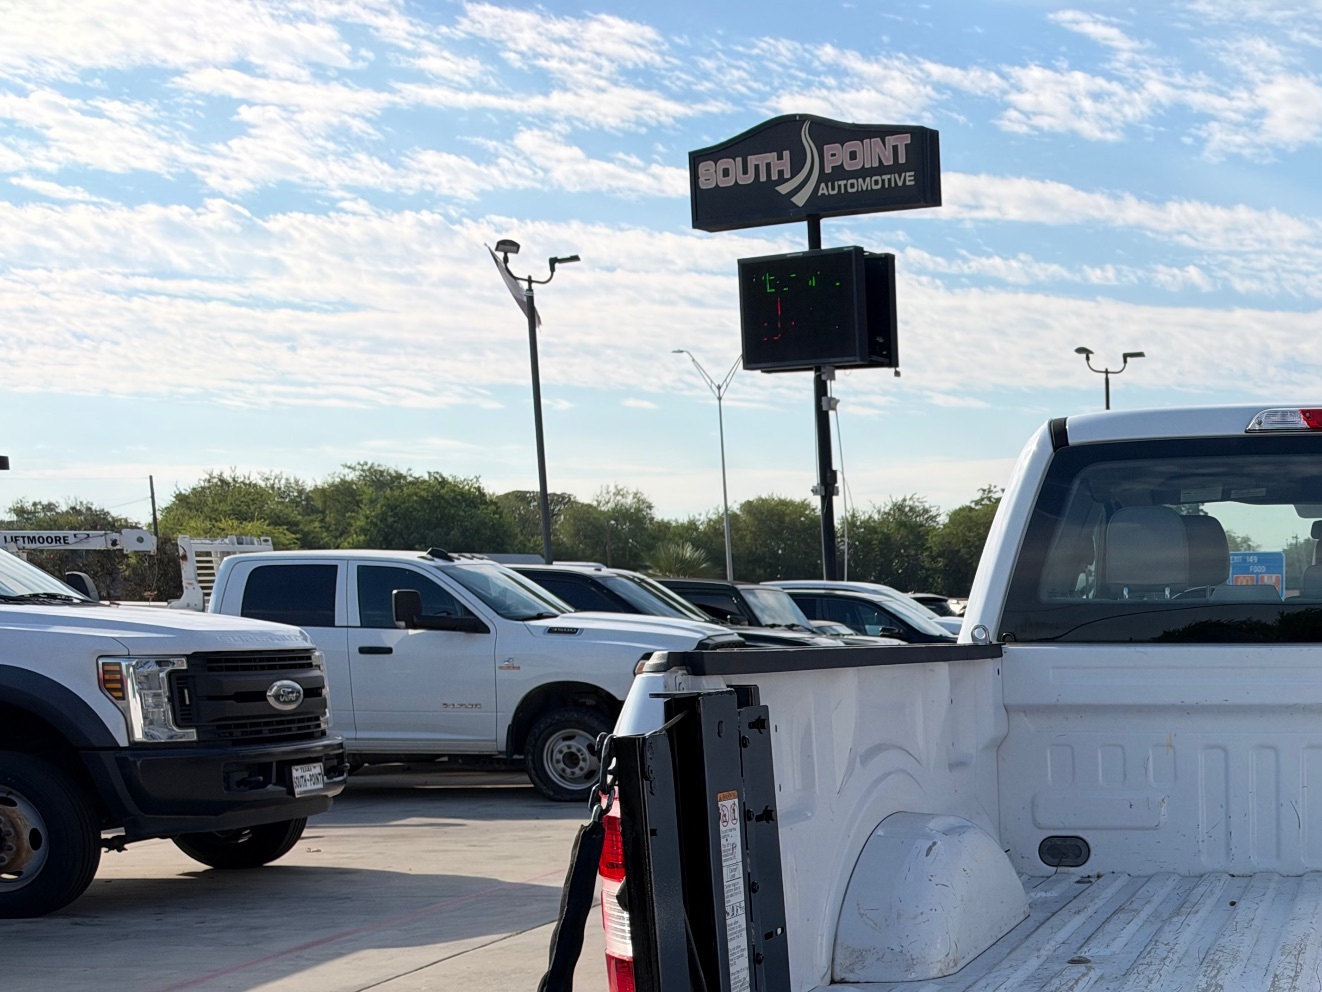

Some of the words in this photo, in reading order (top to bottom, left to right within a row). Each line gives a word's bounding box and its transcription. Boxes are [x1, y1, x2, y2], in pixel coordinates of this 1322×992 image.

[698, 150, 791, 189] SOUTH
[823, 134, 911, 173] POINT
[817, 171, 915, 196] AUTOMOTIVE
[3, 535, 70, 545] LIFTMOORE
[1246, 555, 1258, 563] 149
[1249, 565, 1267, 573] FOOD
[279, 687, 300, 702] Ford
